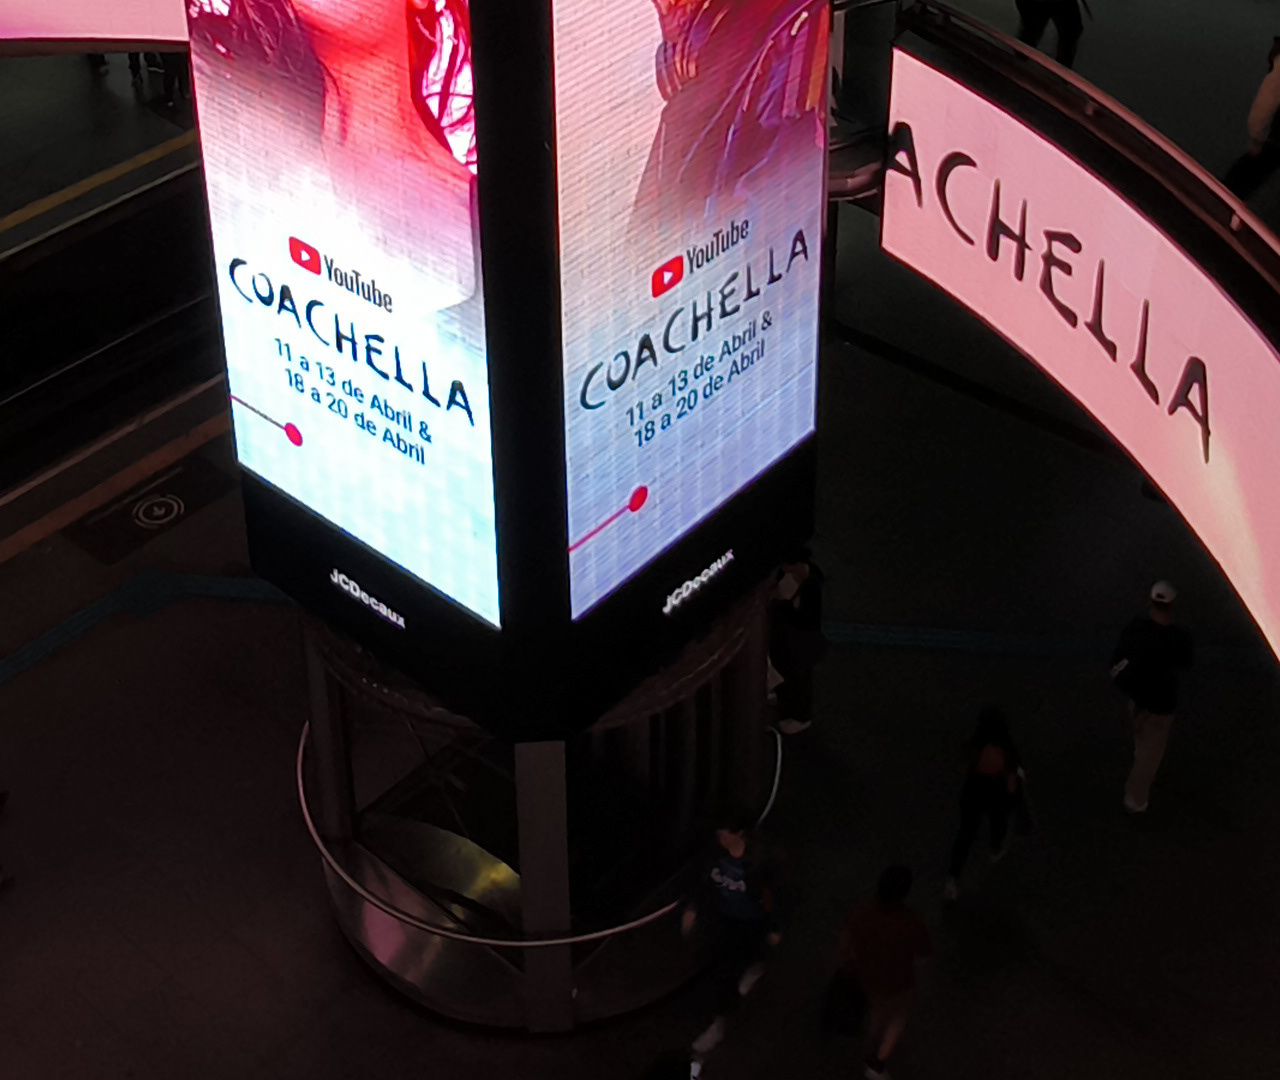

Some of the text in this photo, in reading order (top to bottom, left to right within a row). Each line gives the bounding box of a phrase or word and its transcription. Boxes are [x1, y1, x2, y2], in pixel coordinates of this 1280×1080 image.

[324, 255, 393, 313] YouTube
[686, 219, 749, 274] YouTube
[229, 258, 475, 427] COACHELLA
[580, 229, 809, 410] COACHELLA
[626, 310, 773, 427] 11 a 13 de Abril &
[275, 338, 433, 443] 11 a 13 de Abril &
[285, 368, 425, 465] 18 a 20 de Abril
[634, 338, 765, 448] 18 a 20 de Abril
[329, 567, 406, 629] JCDecaux
[662, 548, 735, 614] JCDecaux
